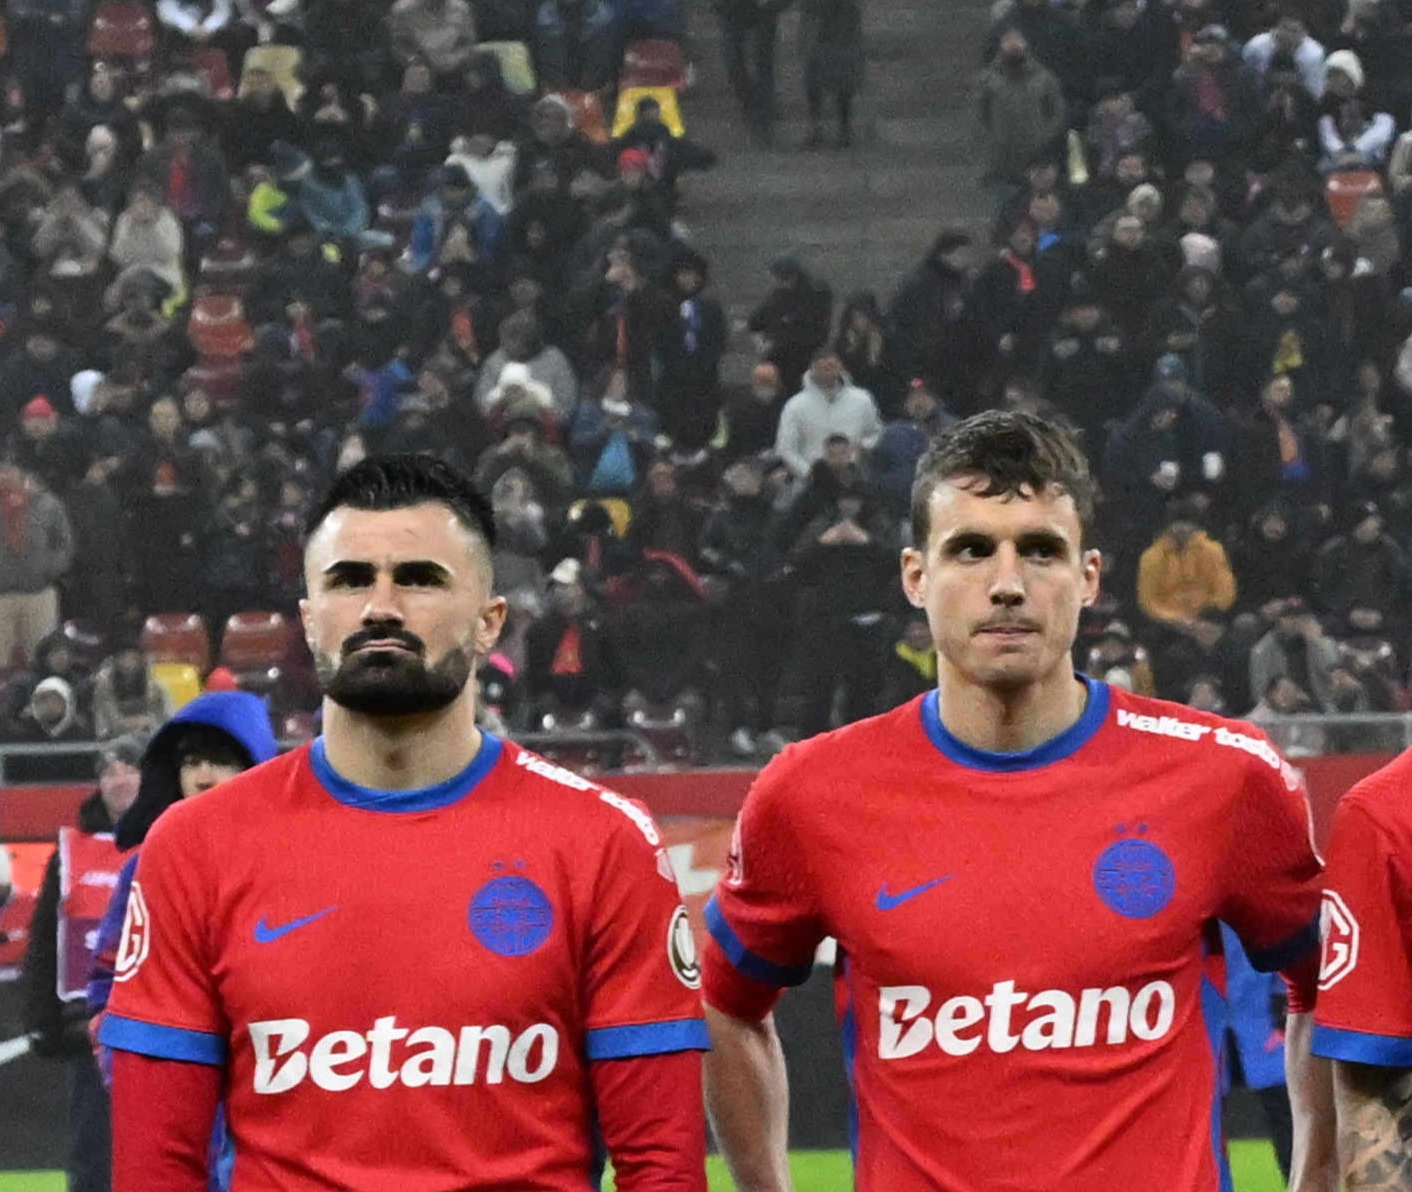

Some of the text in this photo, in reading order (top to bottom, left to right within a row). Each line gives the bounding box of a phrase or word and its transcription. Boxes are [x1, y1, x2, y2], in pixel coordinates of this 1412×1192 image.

[1117, 708, 1213, 742] walter
[247, 1015, 559, 1095] Betano
[878, 979, 1176, 1060] Betano
